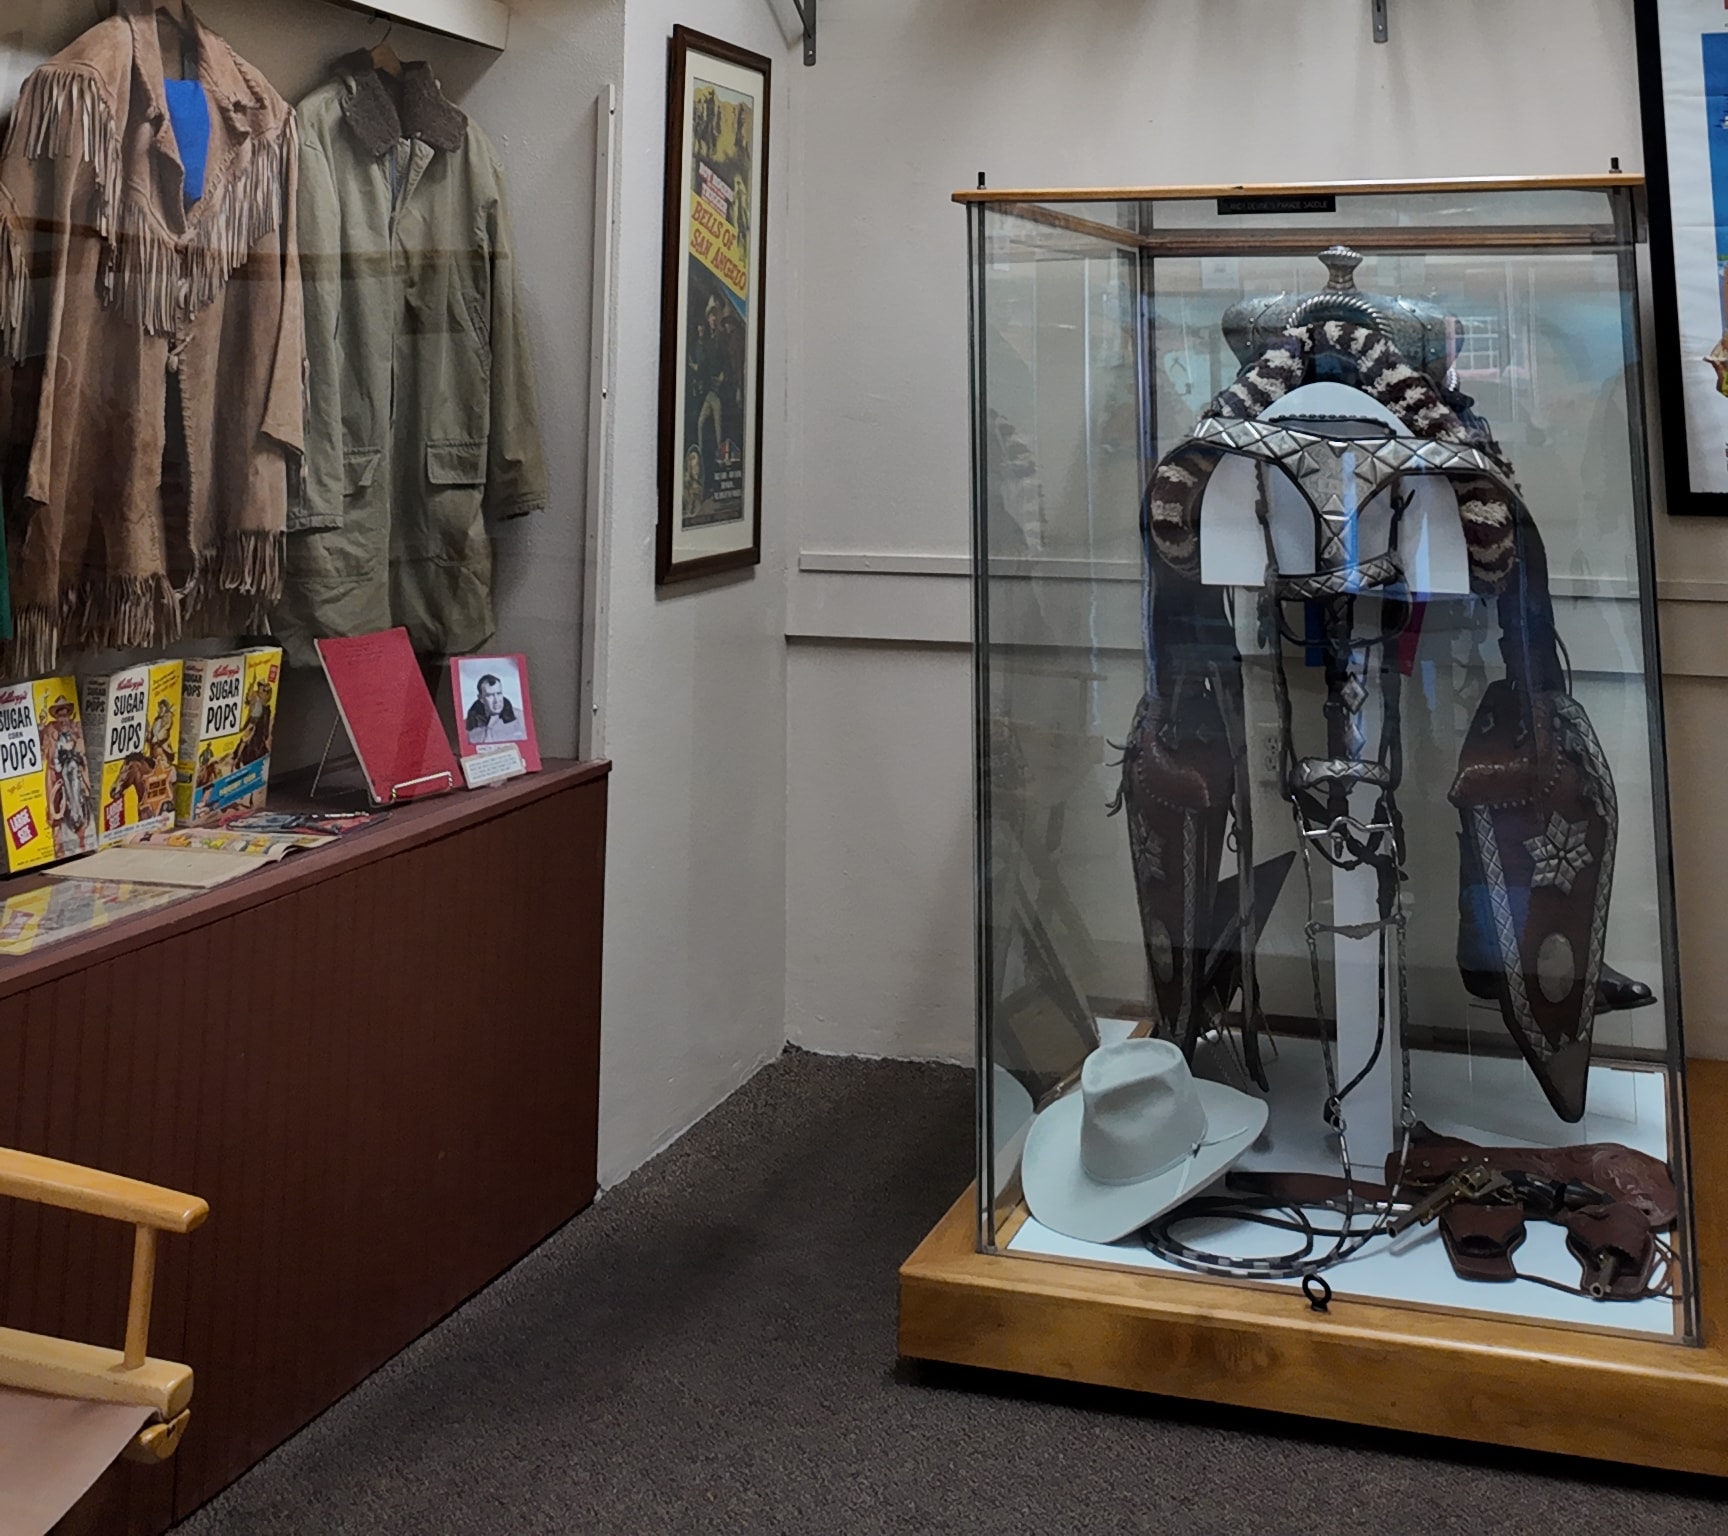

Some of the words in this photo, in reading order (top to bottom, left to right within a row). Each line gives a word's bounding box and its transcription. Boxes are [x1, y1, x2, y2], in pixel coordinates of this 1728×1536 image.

[691, 201, 724, 240] BELLS
[722, 228, 736, 251] OF
[690, 227, 713, 260] SAN
[710, 246, 747, 291] ANGELO
[113, 691, 145, 717] SUGAR
[209, 678, 240, 702] SUGAR
[206, 702, 238, 734] POPS
[8, 730, 23, 740] CORN
[110, 722, 142, 756] POPS
[1, 738, 37, 774] POPS
